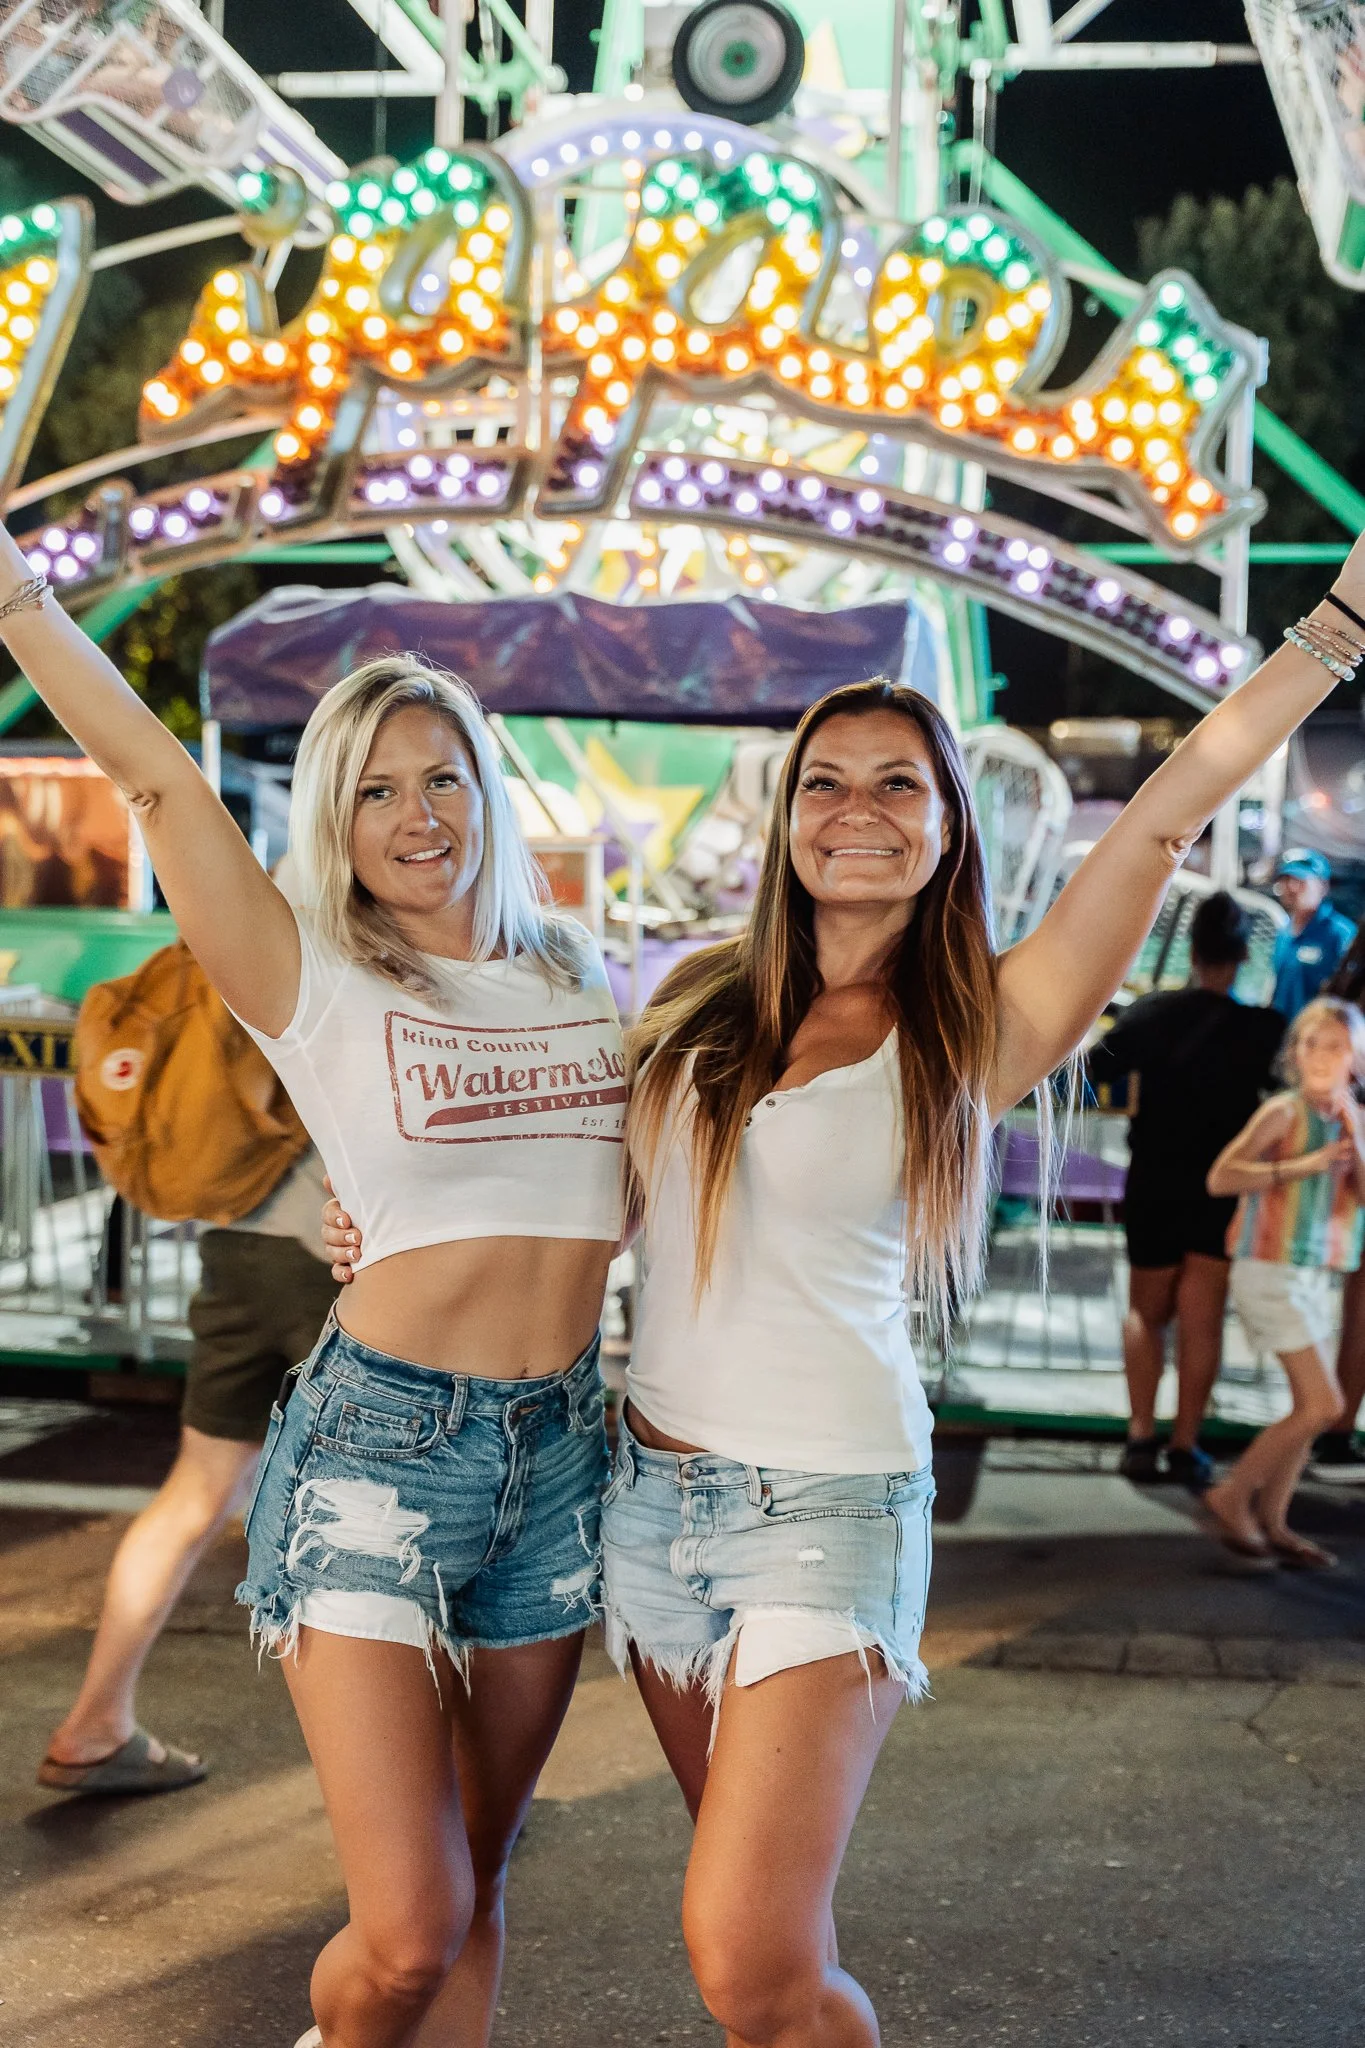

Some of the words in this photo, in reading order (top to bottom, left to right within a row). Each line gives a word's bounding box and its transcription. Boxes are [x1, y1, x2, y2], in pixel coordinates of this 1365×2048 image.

[0, 143, 1268, 560] ipper
[466, 1039, 549, 1053] County
[405, 1047, 626, 1101] Watermelo
[487, 1093, 604, 1117] FESTIVAL
